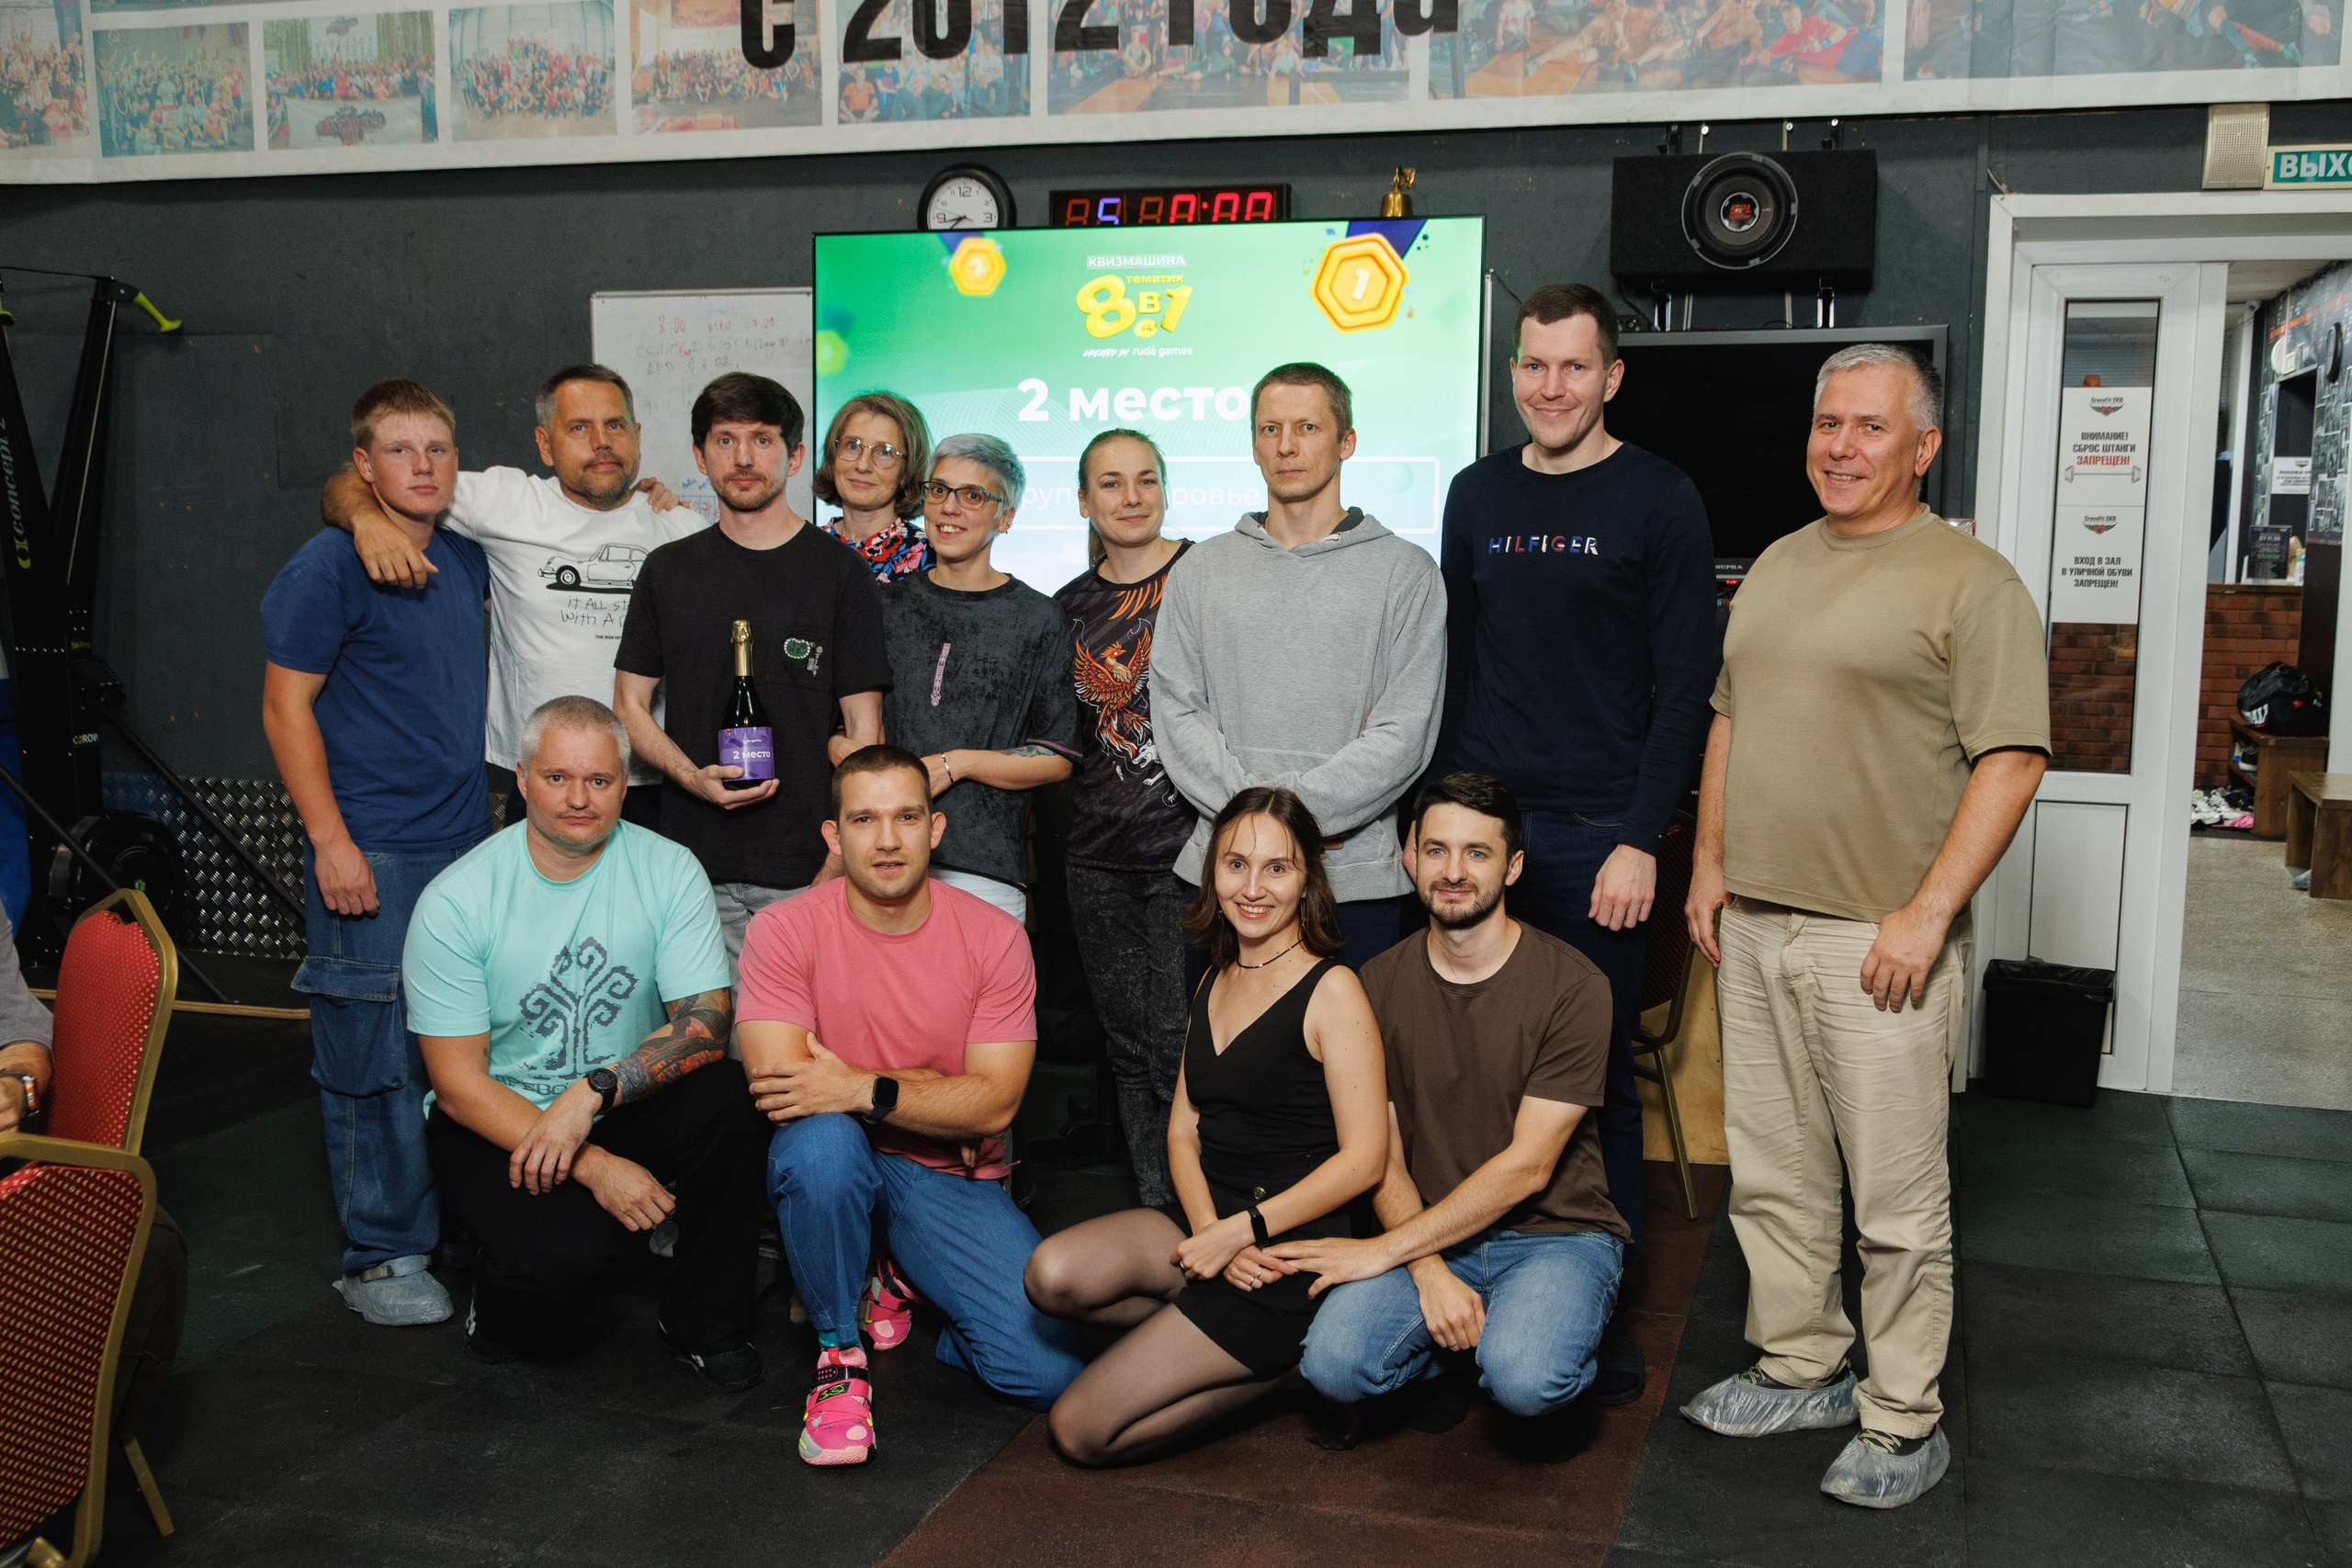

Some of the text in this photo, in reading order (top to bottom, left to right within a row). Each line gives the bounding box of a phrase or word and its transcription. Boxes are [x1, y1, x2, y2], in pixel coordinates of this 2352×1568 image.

[2279, 153, 2352, 178] ВЫХ
[958, 186, 972, 197] 12
[936, 211, 946, 223] 9
[983, 212, 993, 223] 3
[1088, 254, 1186, 268] КВИЗМАШИНА
[1125, 275, 1183, 284] тематик
[1076, 275, 1137, 339] 8
[1160, 285, 1193, 333] 1
[1159, 346, 1193, 357] games
[1017, 378, 1250, 422] 2 место
[2081, 432, 2129, 441] ВНИМАНИЕ!
[2073, 444, 2136, 453] СБРОС ШТАНГИ
[2076, 455, 2131, 467] ЗАПРЕЩЕН!
[1488, 535, 1599, 556] HILFIGER
[2074, 557, 2121, 566] ВХОД В ЗАЛ
[2061, 567, 2132, 577] В УЛИЧНОЙ ОБУВИ
[2074, 579, 2119, 589] ЗАПРЕЩЕН!
[603, 613, 614, 627] A
[733, 750, 771, 760] 2 место
